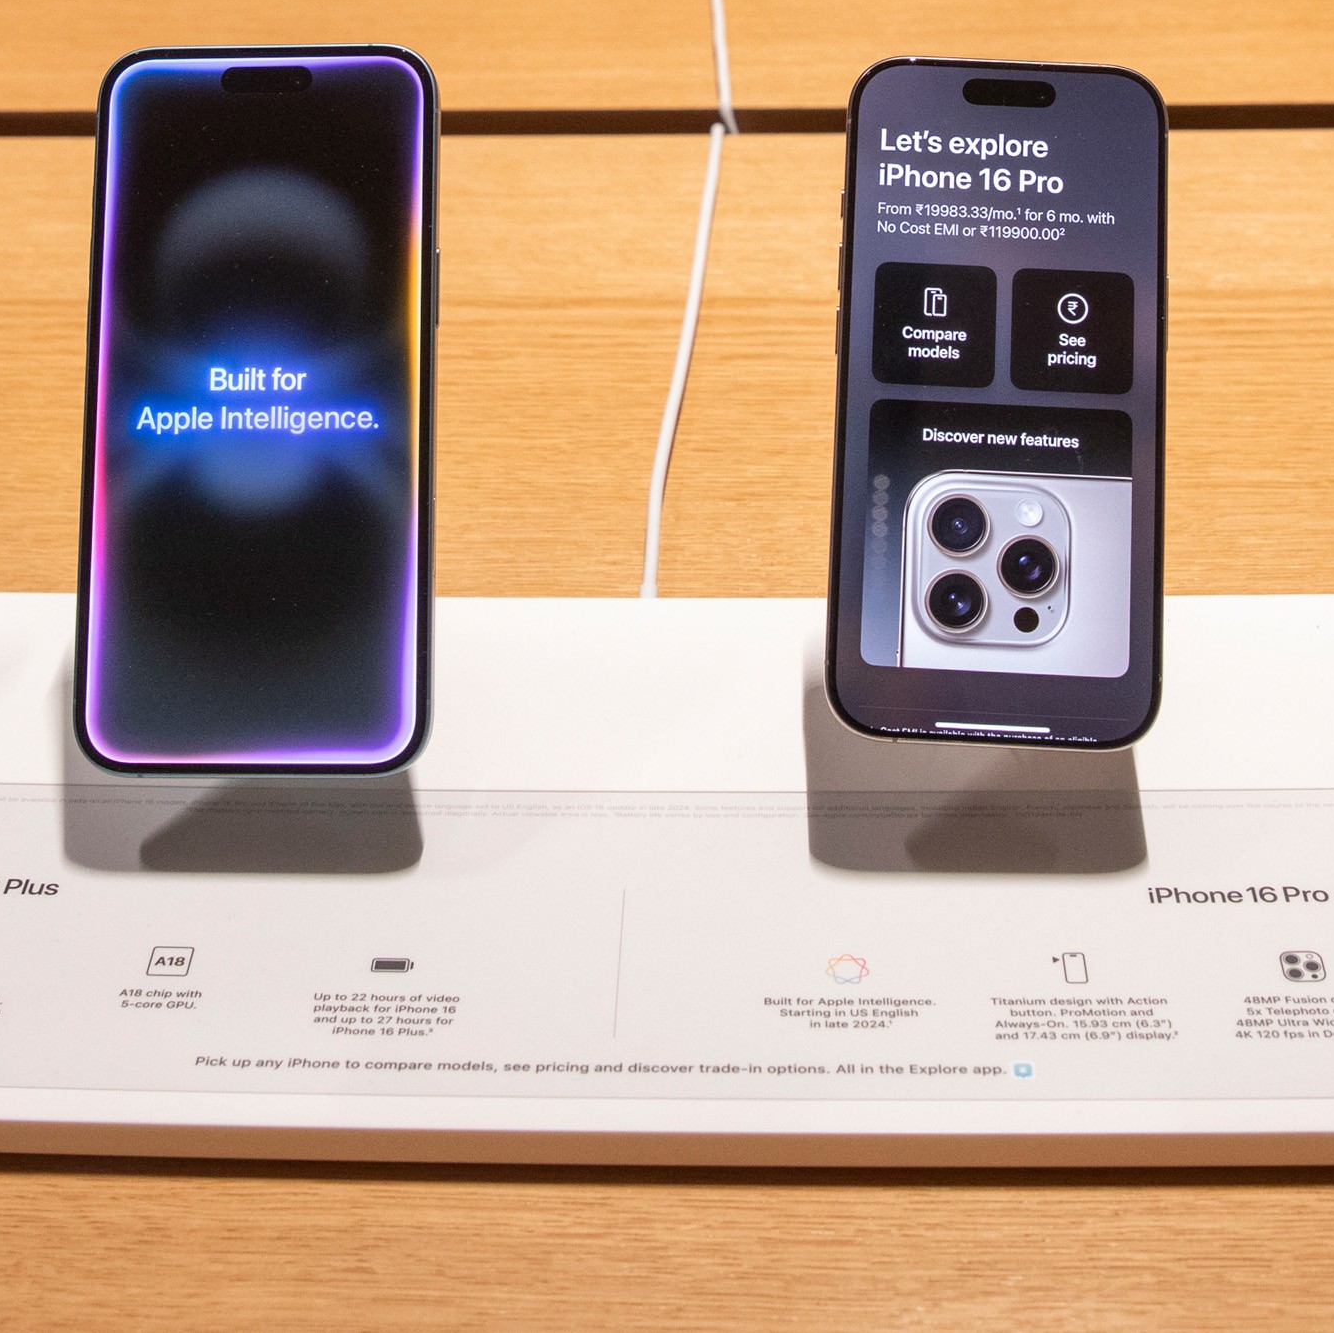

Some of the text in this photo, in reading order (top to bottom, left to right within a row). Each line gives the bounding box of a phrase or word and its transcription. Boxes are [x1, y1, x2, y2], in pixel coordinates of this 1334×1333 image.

[880, 127, 1048, 161] Let's explore
[878, 163, 1063, 193] iPhone 16 Pro
[877, 201, 911, 216] From
[1023, 207, 1043, 222] for
[1046, 208, 1055, 222] 6
[1059, 212, 1083, 223] mo.
[1086, 210, 1115, 225] with
[876, 219, 896, 234] No
[899, 220, 931, 235] Cost
[933, 222, 959, 236] EMI
[961, 226, 976, 237] or
[901, 325, 967, 343] Compare
[1058, 333, 1086, 347] See
[907, 344, 960, 359] models
[1047, 352, 1096, 370] pricing
[209, 368, 307, 391] Built for
[136, 406, 378, 435] Apple Intelligence.
[922, 427, 1079, 448] Discover new features
[2, 876, 59, 895] Plus
[1147, 885, 1243, 904] iPhone
[1246, 884, 1277, 903] 16
[1282, 884, 1329, 902] Pro
[153, 956, 185, 966] A18
[118, 988, 202, 999] A18 chip with
[990, 996, 1167, 1007] Titanium design with Action
[1243, 995, 1281, 1004] 48MP
[1284, 995, 1327, 1004] Fusion
[120, 999, 197, 1009] 5-core GPU.
[1009, 1007, 1153, 1017] button. ProMotion and
[994, 1019, 1068, 1030] Always-On.
[1073, 1019, 1107, 1028] 15.93
[994, 1031, 1019, 1040] and
[1022, 1031, 1057, 1040] 17.43
[194, 1055, 1005, 1077] Pick up any iPhone to compare models, see pricing and discover trade-in options. All in the Explore app.
